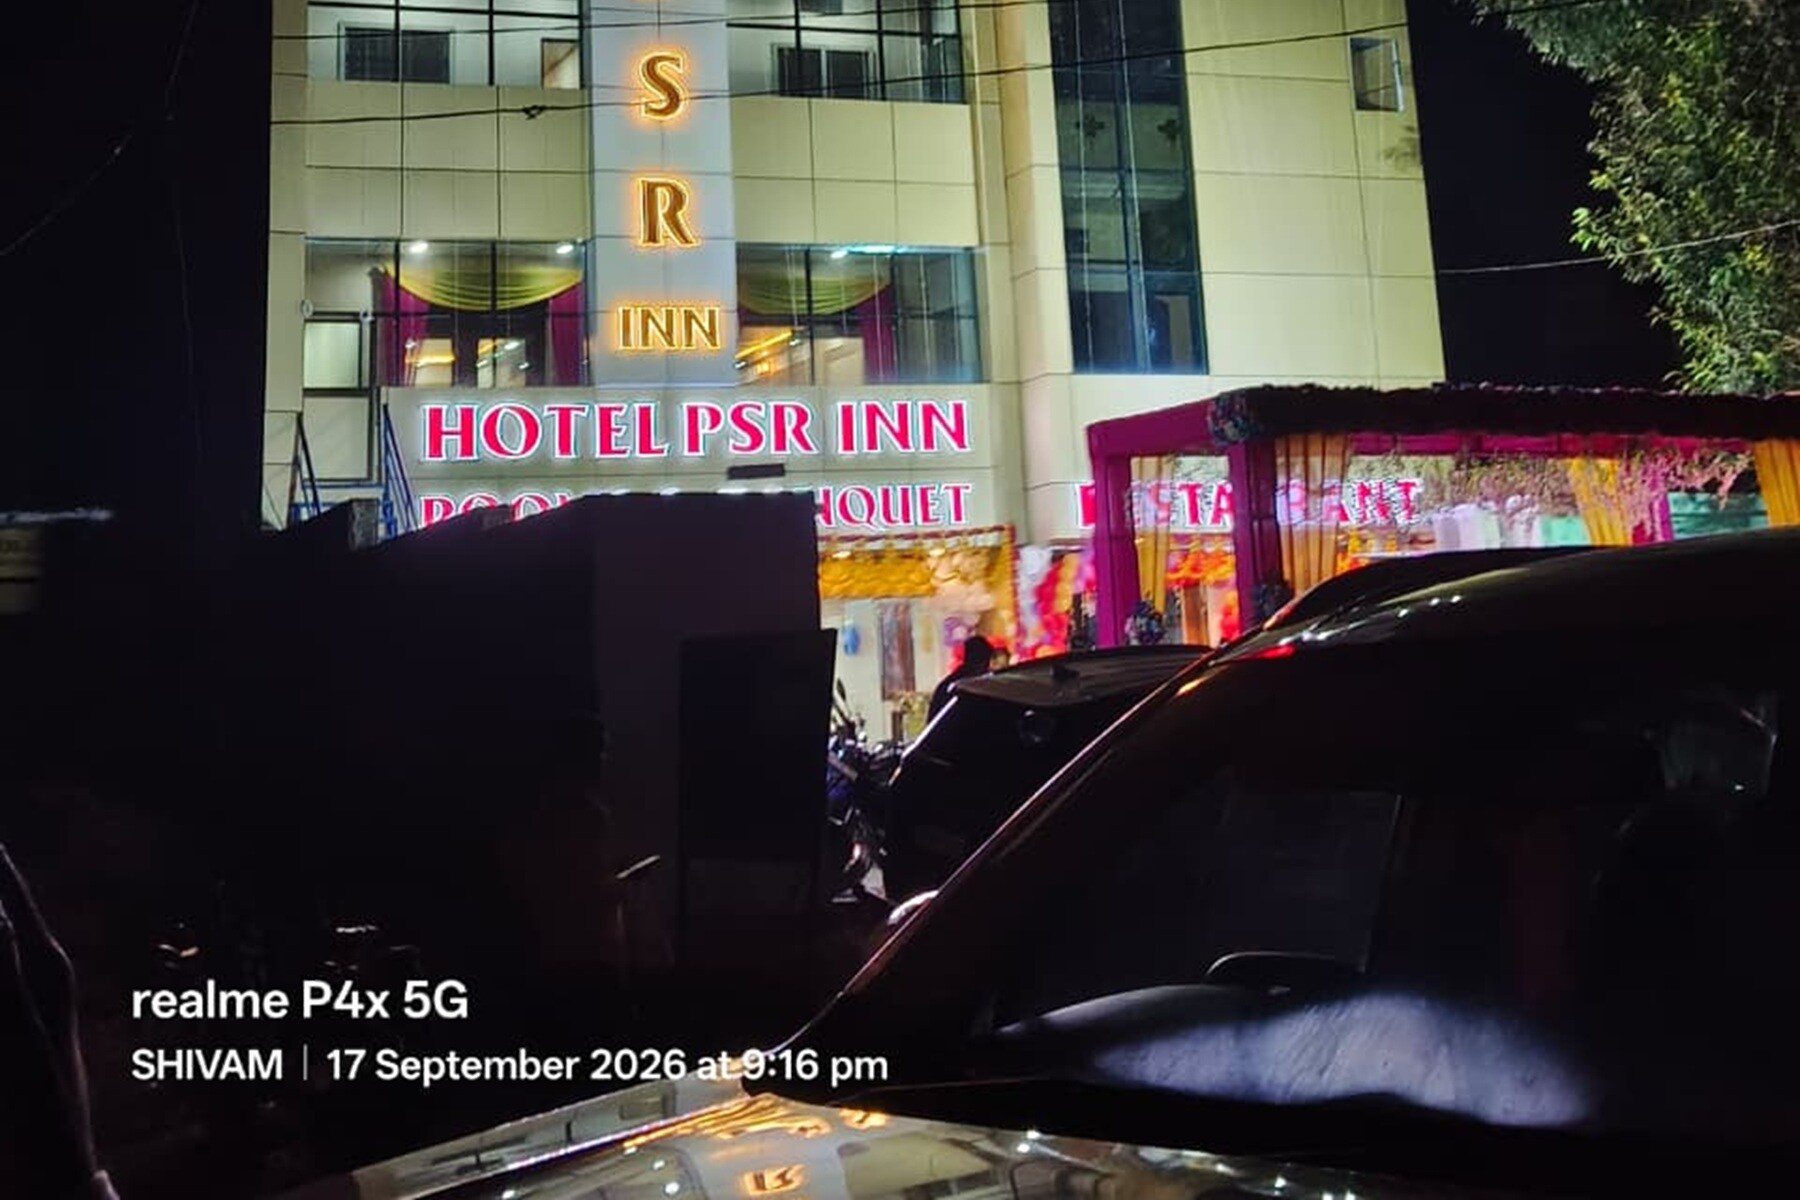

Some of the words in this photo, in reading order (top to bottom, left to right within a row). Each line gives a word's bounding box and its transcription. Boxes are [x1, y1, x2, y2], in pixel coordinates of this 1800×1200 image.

[617, 305, 722, 351] INN
[423, 402, 667, 460] HOTEL
[684, 402, 818, 456] PSR
[836, 400, 971, 453] INN
